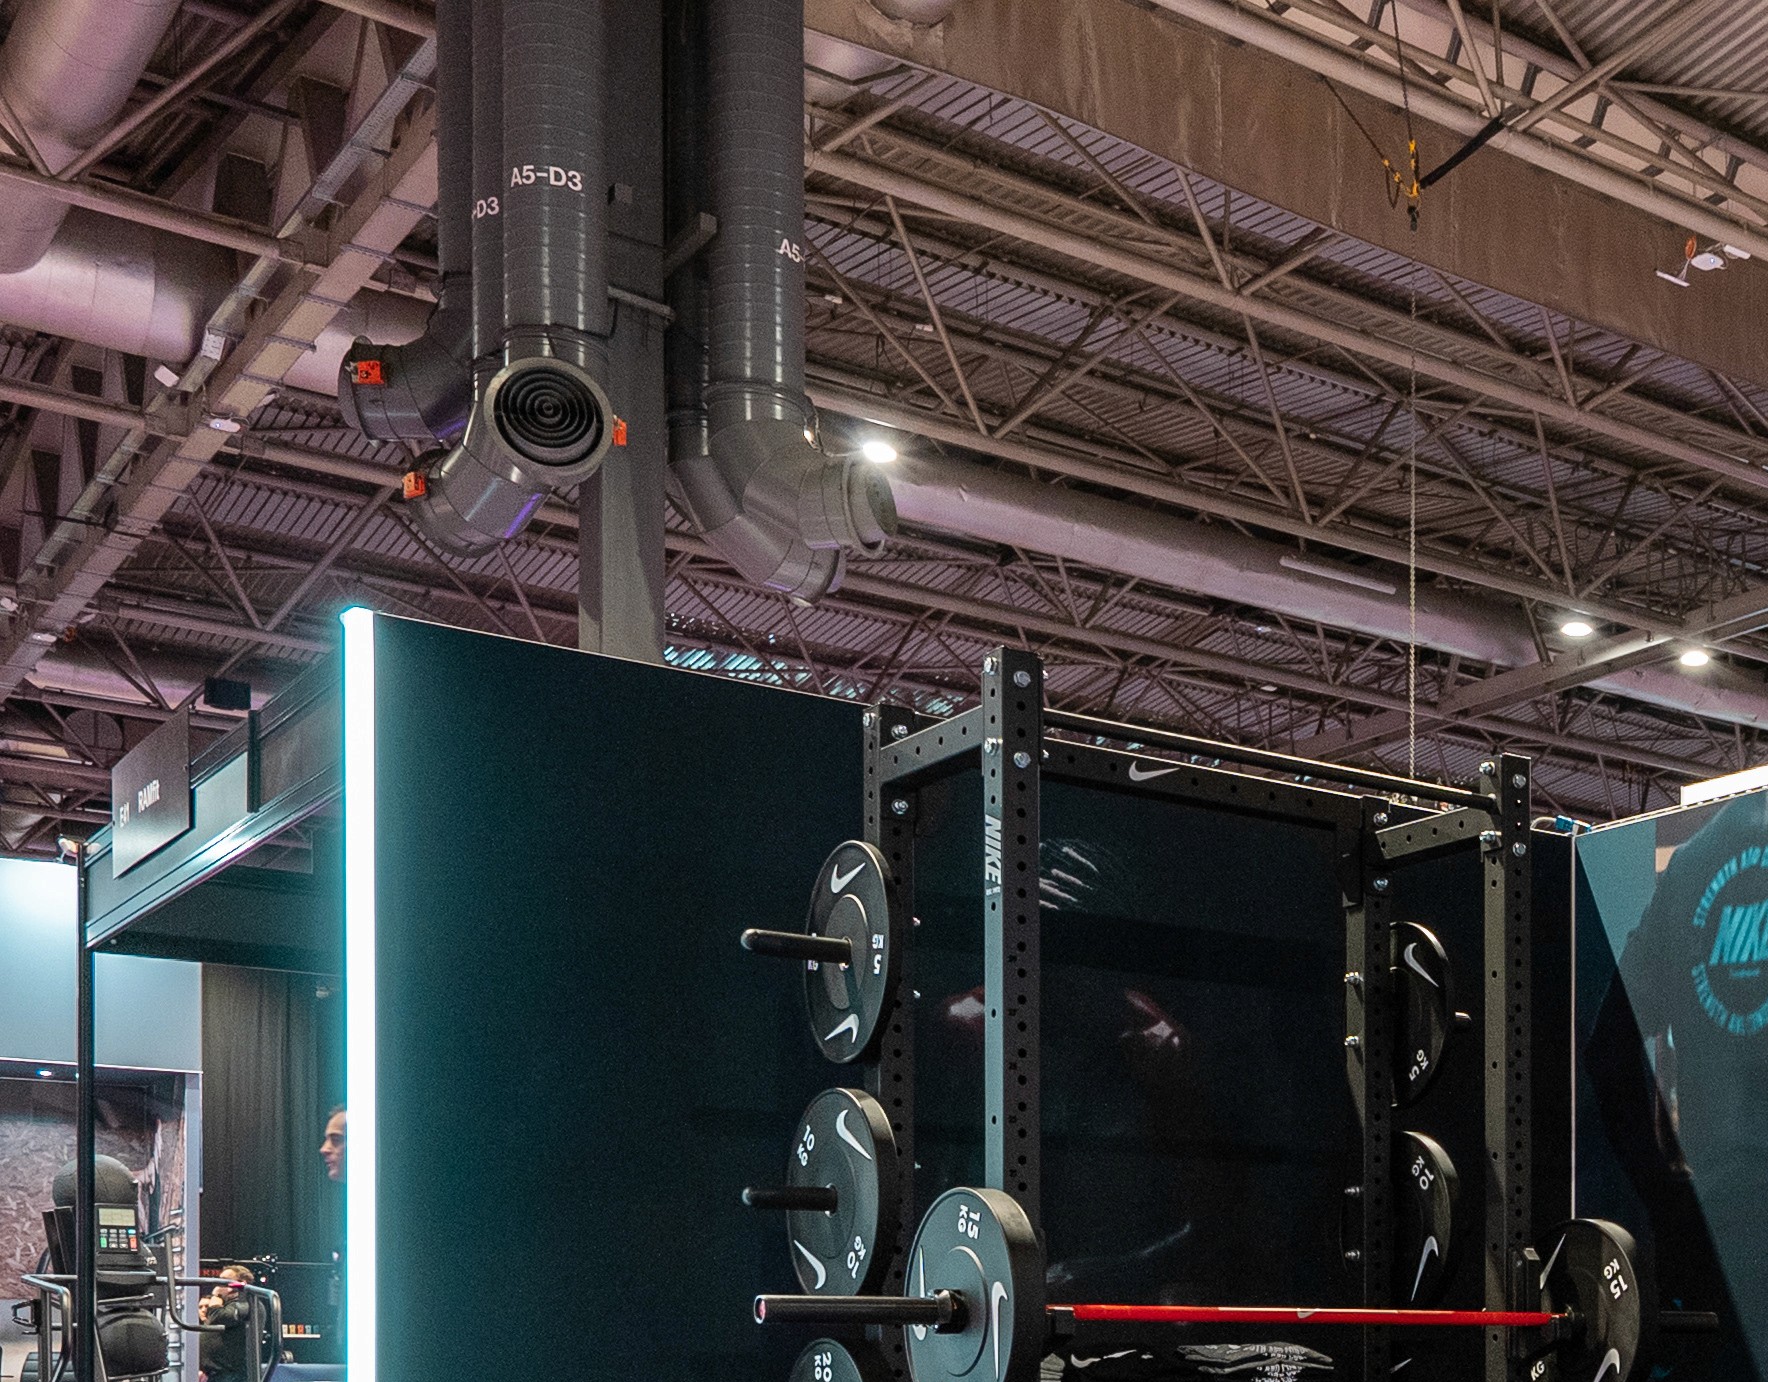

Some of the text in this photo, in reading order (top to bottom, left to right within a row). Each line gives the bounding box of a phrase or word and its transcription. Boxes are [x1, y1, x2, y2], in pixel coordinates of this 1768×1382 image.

[510, 165, 583, 192] A5-D3
[985, 814, 1002, 885] NIKE
[871, 934, 885, 950] KG
[873, 954, 882, 975] 5
[1416, 1050, 1429, 1071] KG
[1409, 1065, 1420, 1081] 5
[802, 1125, 815, 1151] 10
[797, 1144, 808, 1166] KG
[1412, 1156, 1425, 1177] KG
[1419, 1172, 1435, 1190] 10
[957, 1204, 968, 1234] KG
[967, 1211, 981, 1240] 15
[853, 1236, 867, 1260] KG
[847, 1252, 859, 1279] 10
[1603, 1259, 1620, 1278] KG
[1610, 1274, 1628, 1300] 15
[814, 1355, 822, 1380] KG
[822, 1352, 832, 1382] 20
[1530, 1361, 1545, 1381] KG
